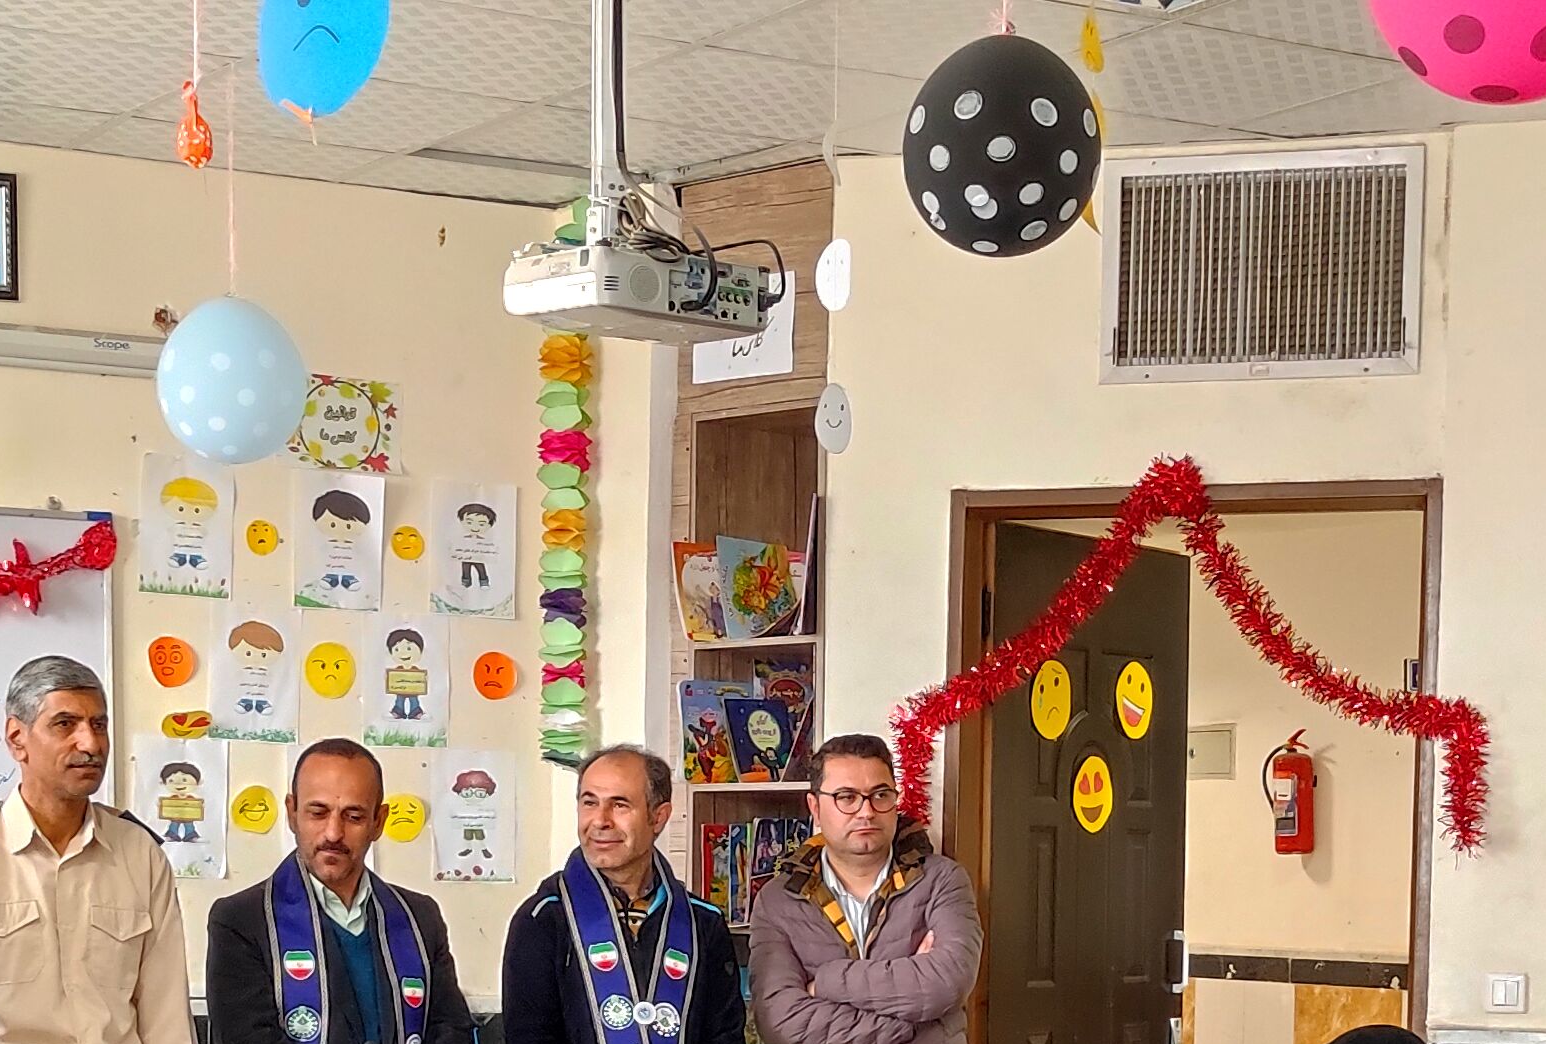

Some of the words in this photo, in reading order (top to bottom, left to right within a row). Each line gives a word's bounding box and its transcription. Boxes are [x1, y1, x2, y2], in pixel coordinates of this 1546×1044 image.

[93, 337, 130, 351] Scope
[324, 405, 357, 421] قوانین
[319, 428, 330, 441] ما
